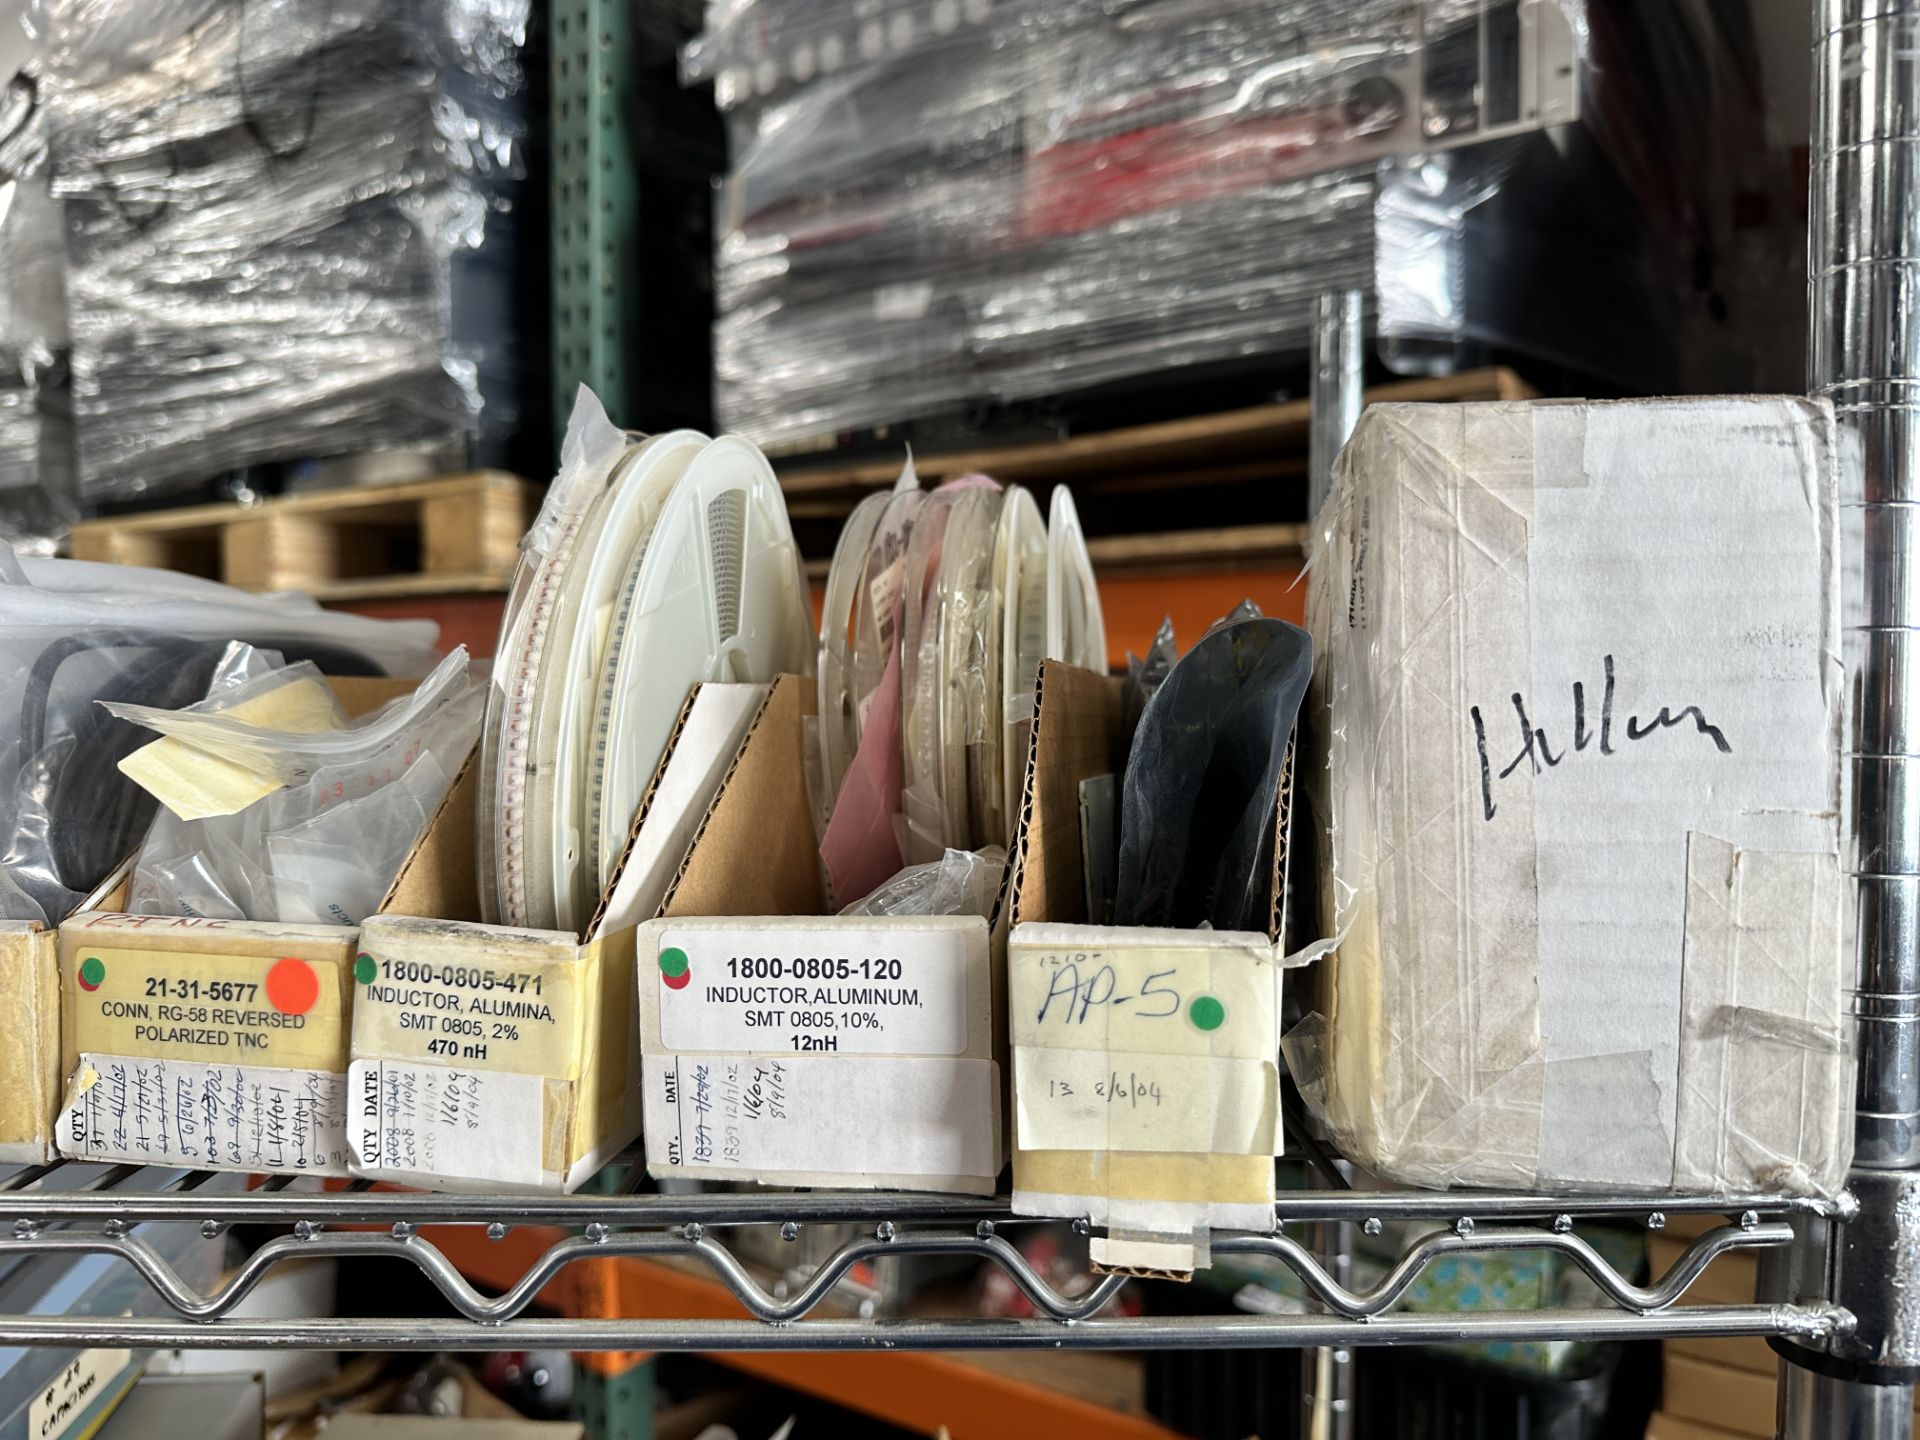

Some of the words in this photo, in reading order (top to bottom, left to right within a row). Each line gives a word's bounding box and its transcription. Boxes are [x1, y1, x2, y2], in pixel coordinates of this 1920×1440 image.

[382, 959, 543, 995] 1800-0805-471
[727, 958, 902, 981] 1800-0805-120
[145, 977, 258, 1003] 21-31-5677
[367, 985, 464, 1014] INDUCTOR,
[469, 998, 556, 1024] ALUMINA,
[1037, 963, 1181, 1025] AP-5
[101, 1002, 152, 1021] CONN,
[158, 1005, 207, 1023] RG-58
[213, 1008, 305, 1030] REVERSED
[400, 1012, 437, 1031] SMT
[442, 1017, 487, 1039] 0805,
[492, 1023, 520, 1041] 2%
[745, 1010, 785, 1027] SMT
[135, 1025, 229, 1046] POLARIZED
[234, 1032, 269, 1048] TNC
[427, 1039, 458, 1056] 470
[463, 1043, 488, 1060] nH
[791, 1035, 838, 1051] 12nH
[365, 1071, 378, 1117] DATE
[664, 1071, 676, 1103] DATE
[1050, 1079, 1074, 1097] 13
[72, 1109, 87, 1142] QTY
[363, 1128, 380, 1163] QTY
[402, 1128, 416, 1167] 2008
[668, 1135, 680, 1165] QTY.
